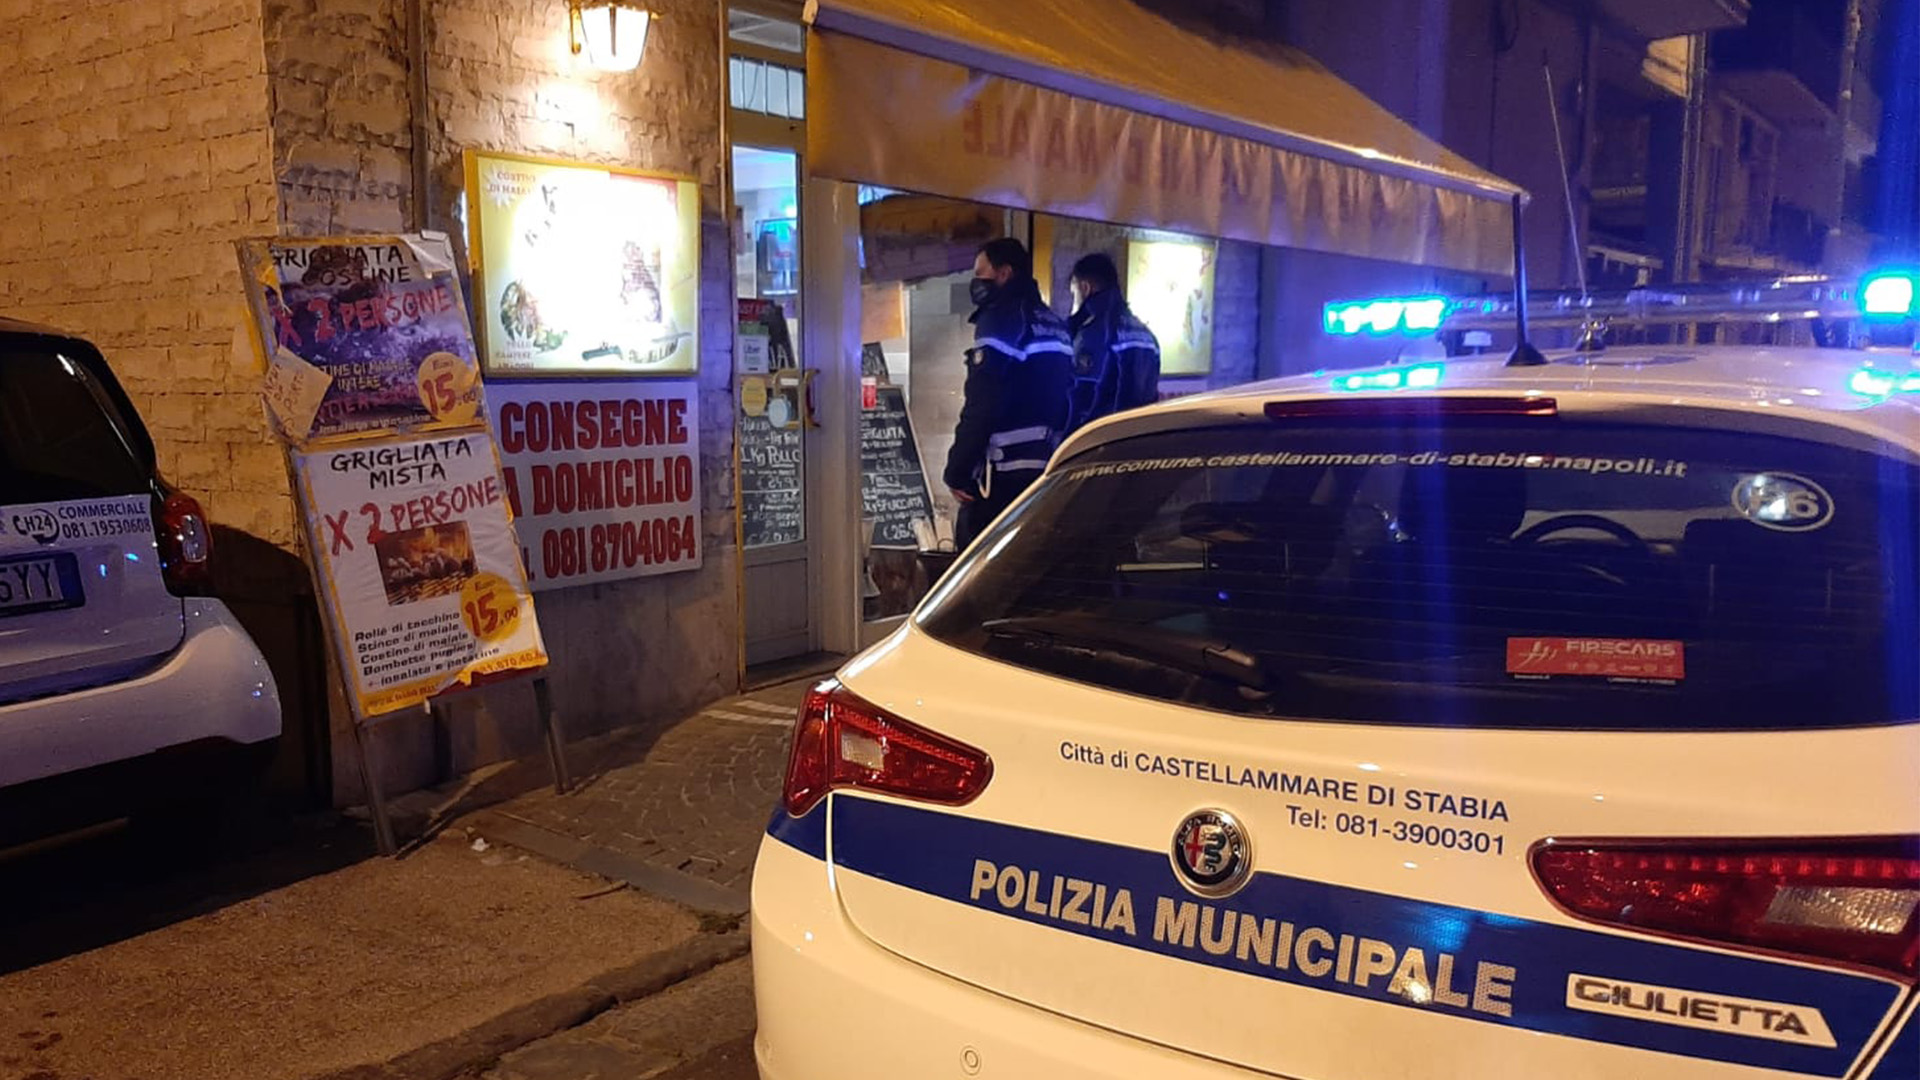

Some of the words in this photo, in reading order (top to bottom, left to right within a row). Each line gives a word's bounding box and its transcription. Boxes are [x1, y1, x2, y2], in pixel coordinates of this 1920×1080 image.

[307, 297, 337, 342] 2
[341, 284, 451, 331] PERSONE
[501, 398, 688, 453] CONSEGNE
[331, 438, 472, 472] GRIGLIATA
[1068, 451, 1688, 481] www.comune.castellammare-di-stabia.napoli.it
[370, 462, 447, 490] MISTA
[532, 455, 693, 516] DOMICILIO
[58, 502, 147, 520] COMMERCIALE
[324, 510, 354, 556] X
[360, 502, 388, 544] 2
[390, 476, 500, 532] PERSONE
[62, 518, 151, 539] 081.19530608
[542, 526, 588, 580] 081
[590, 515, 696, 573] 8704064
[358, 636, 400, 653] Stinco
[404, 631, 414, 642] di
[419, 622, 459, 638] maiale
[392, 623, 403, 634] di
[407, 612, 460, 630] tacchino
[361, 646, 410, 664] Costine
[414, 641, 425, 652] di
[429, 631, 468, 648] maiale
[1565, 640, 1676, 656] FIRECARS
[363, 653, 427, 676] Bombette
[381, 664, 431, 686] insalata
[1060, 741, 1105, 767] Città
[1111, 750, 1129, 770] di
[1135, 753, 1358, 803] CASTELLAMMARE
[1367, 786, 1396, 808] DI
[1404, 789, 1511, 823] STABIA
[1286, 805, 1328, 831] Tel:
[1336, 812, 1505, 856] 081-3900301
[970, 859, 1137, 937] POLIZIA
[1153, 896, 1516, 1018] MUNICIPALE
[1574, 977, 1810, 1036] GIULIETTA
